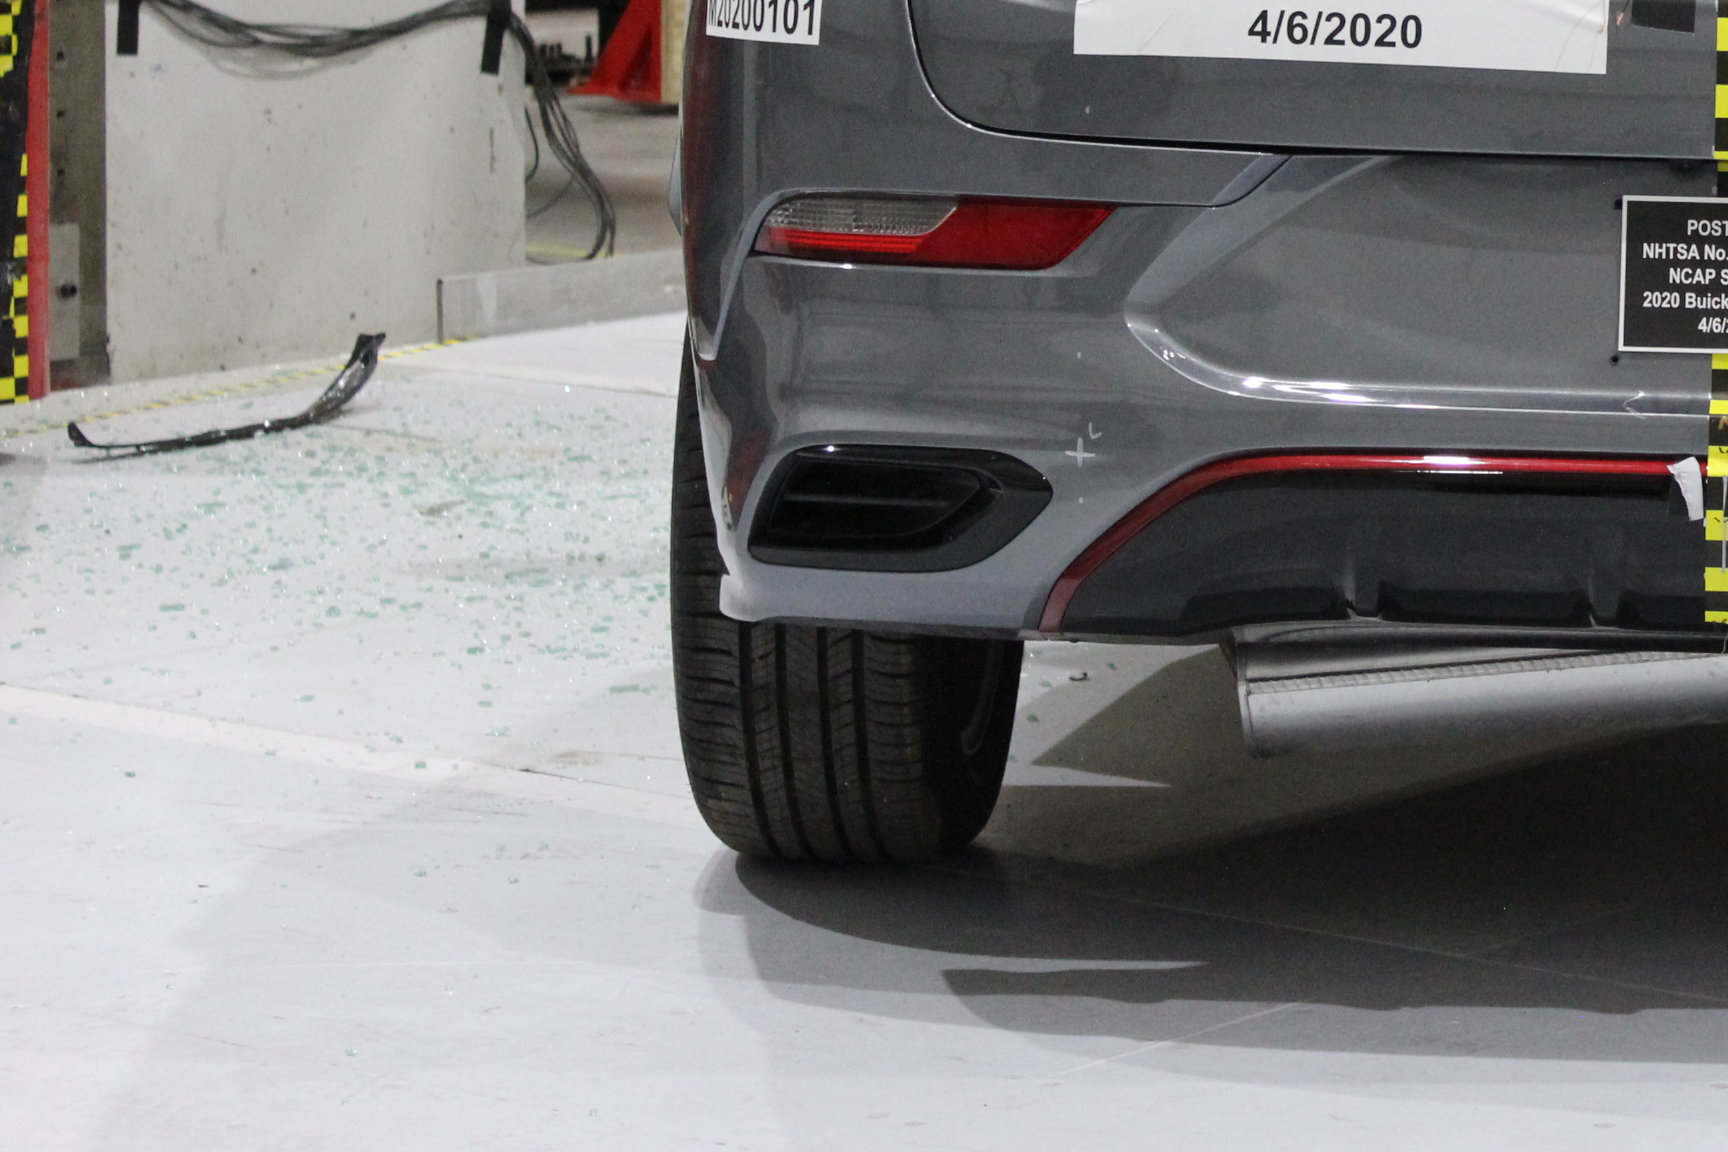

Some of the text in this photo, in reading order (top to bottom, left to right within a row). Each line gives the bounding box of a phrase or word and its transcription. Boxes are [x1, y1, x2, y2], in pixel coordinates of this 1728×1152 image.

[1247, 10, 1423, 48] 4/6/2020
[1642, 243, 1700, 260] NHTSA
[1669, 268, 1716, 285] NCAP
[1642, 292, 1680, 308] 2020
